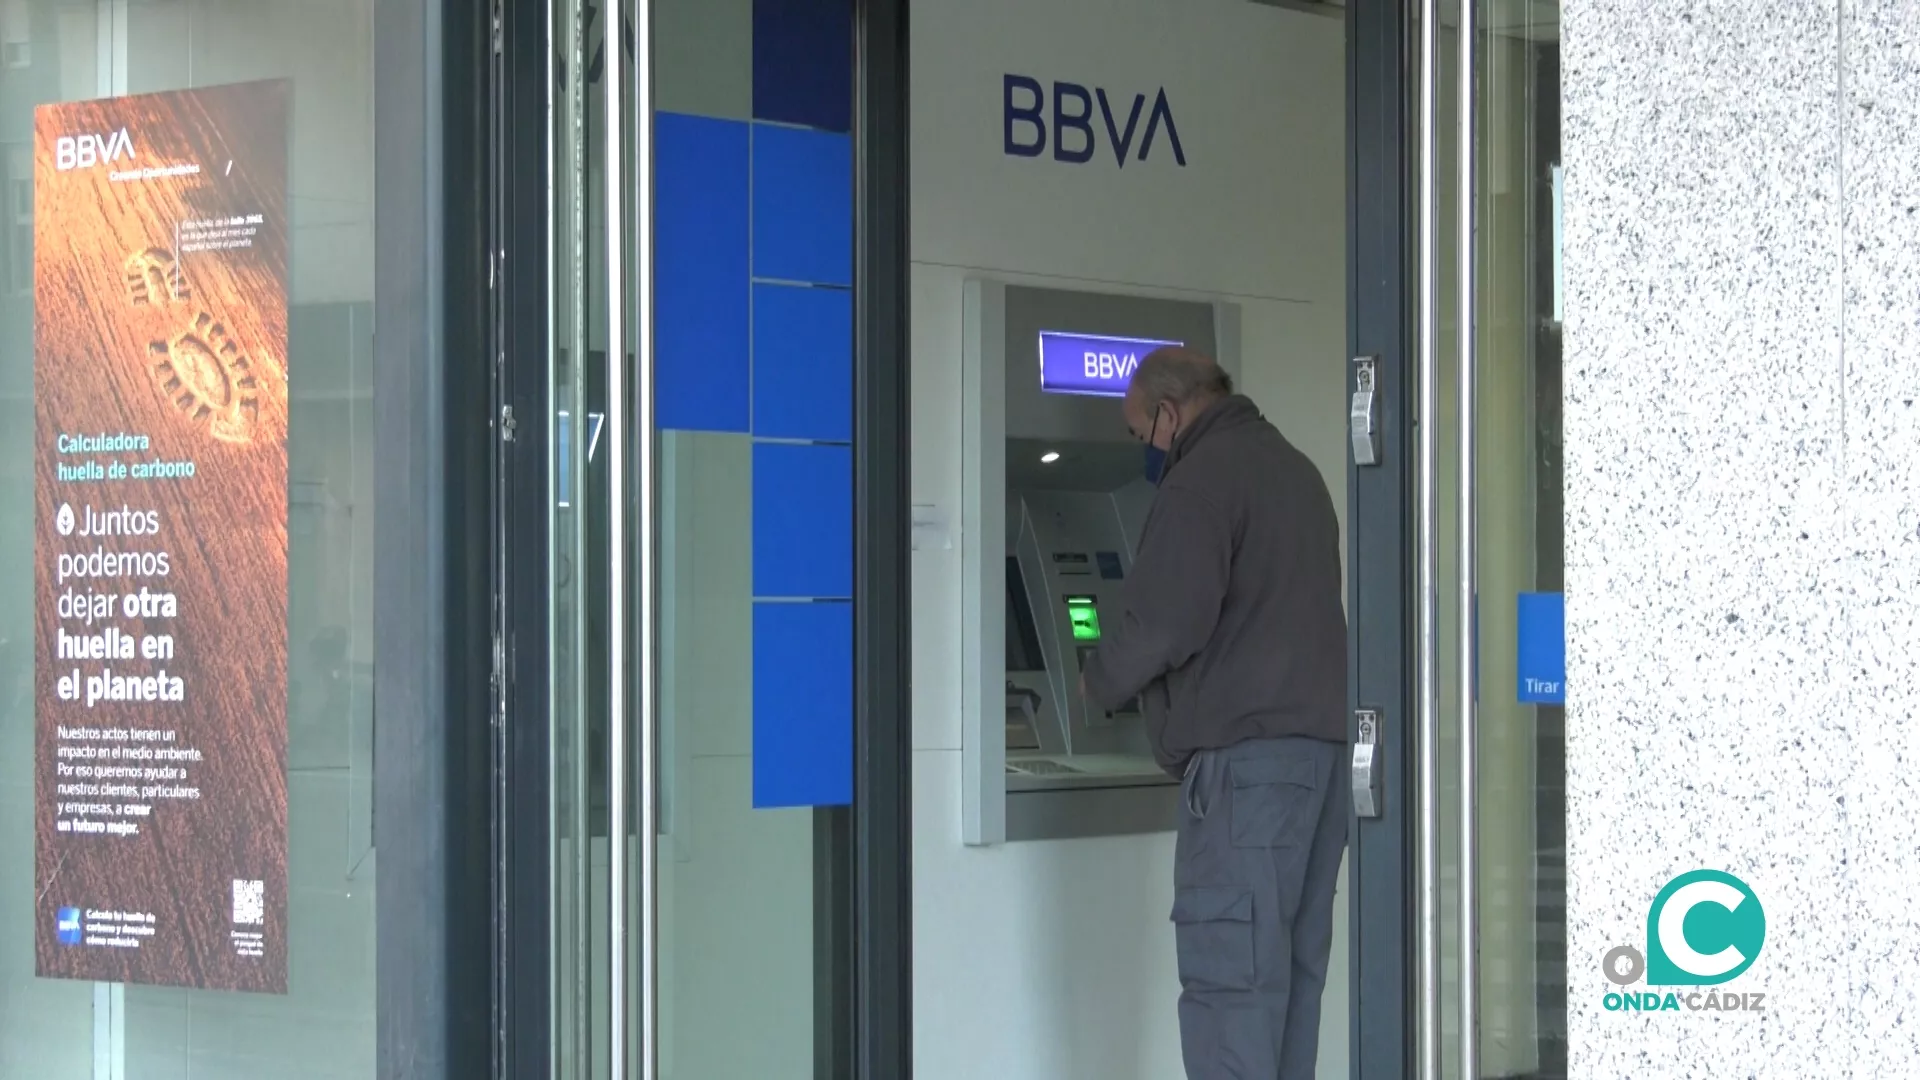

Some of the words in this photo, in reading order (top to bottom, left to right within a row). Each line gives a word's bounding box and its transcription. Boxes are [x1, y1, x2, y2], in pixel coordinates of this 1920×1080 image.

[1004, 73, 1186, 169] BBVA
[57, 126, 136, 170] BBVA
[58, 431, 150, 453] Calculadora
[58, 460, 104, 481] huella
[108, 460, 127, 480] de
[131, 457, 195, 479] carbono
[79, 503, 160, 537] Juntos
[58, 545, 170, 585] podemos
[58, 586, 118, 626] dejar
[123, 586, 177, 618] otra
[58, 627, 135, 659] huella
[141, 634, 174, 659] en
[58, 668, 80, 700] el
[87, 668, 184, 707] planeta
[1525, 677, 1560, 694] Tirar
[57, 725, 101, 740] Nuestros
[102, 727, 129, 740] actos
[130, 727, 161, 741] tienen
[163, 729, 176, 741] un
[57, 745, 96, 760] impacto
[98, 747, 110, 758] en
[112, 746, 121, 759] el
[122, 746, 153, 760] medio
[154, 746, 203, 761] ambiente.
[57, 762, 74, 776] Por
[76, 766, 93, 777] eso
[94, 766, 142, 782] queremos
[144, 765, 178, 781] ayudar
[180, 768, 187, 779] a
[57, 782, 99, 796] nuestros
[100, 782, 140, 799] clientes,
[141, 784, 200, 800] particulares
[57, 802, 64, 816] y
[65, 802, 114, 816] empresas,
[116, 804, 122, 815] a
[124, 803, 152, 816] crear
[57, 820, 71, 831] un
[72, 818, 105, 833] futuro
[107, 820, 140, 837] mejor.
